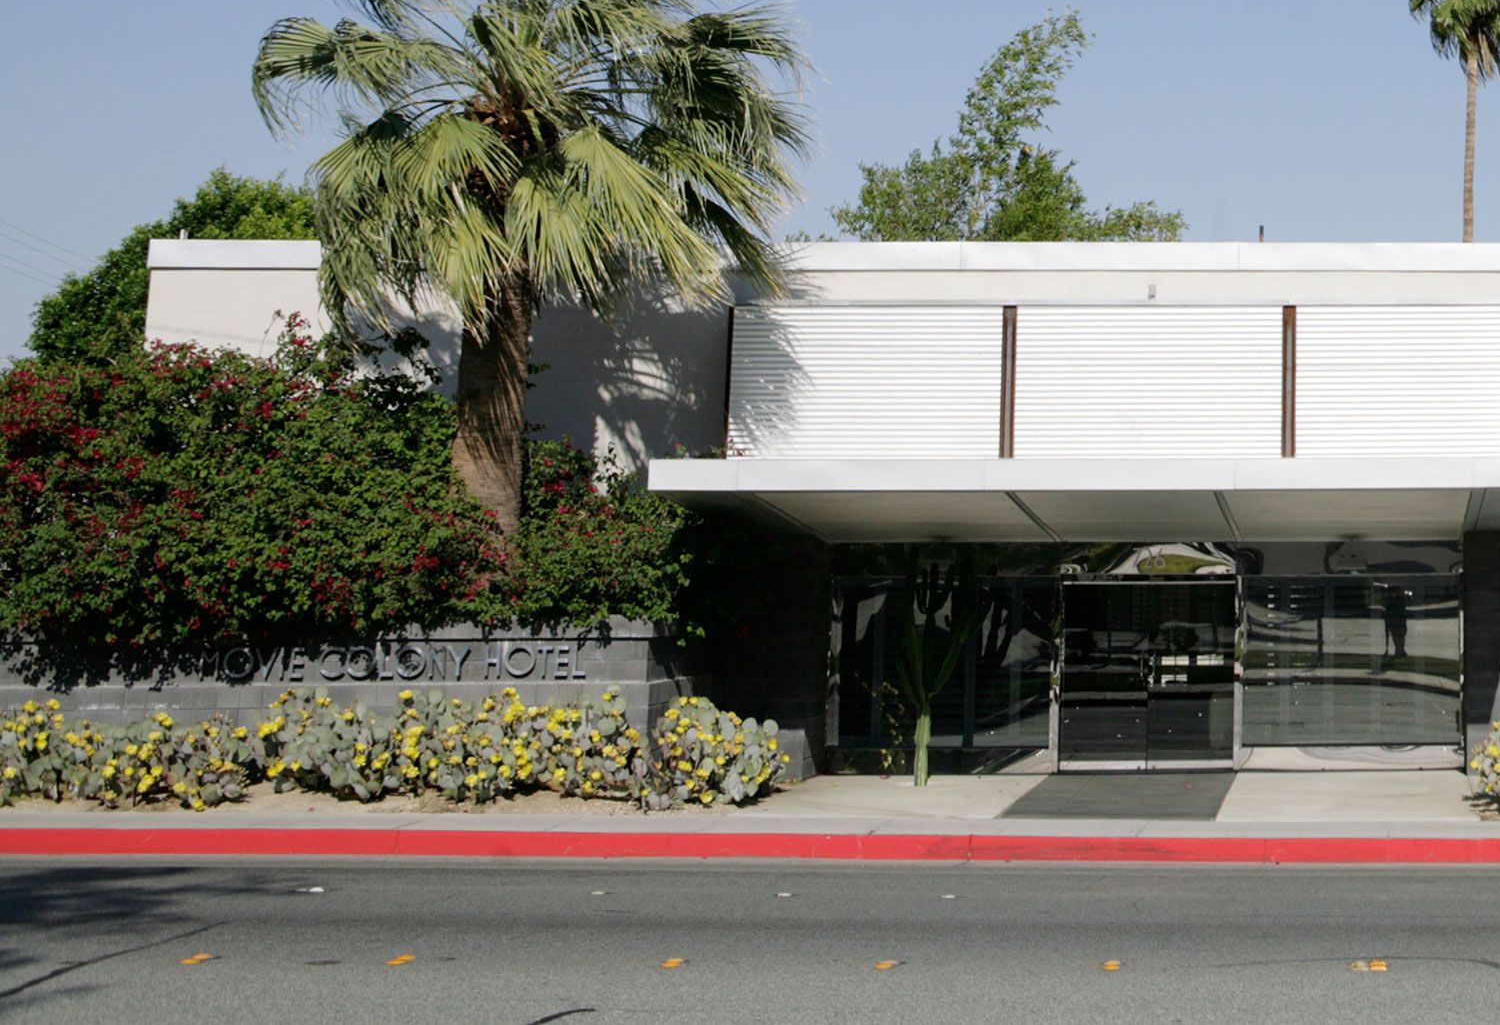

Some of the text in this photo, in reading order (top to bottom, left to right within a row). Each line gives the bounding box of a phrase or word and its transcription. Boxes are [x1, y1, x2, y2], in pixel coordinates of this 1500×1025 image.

[200, 643, 586, 680] MOVIE COLONY HOTEL
